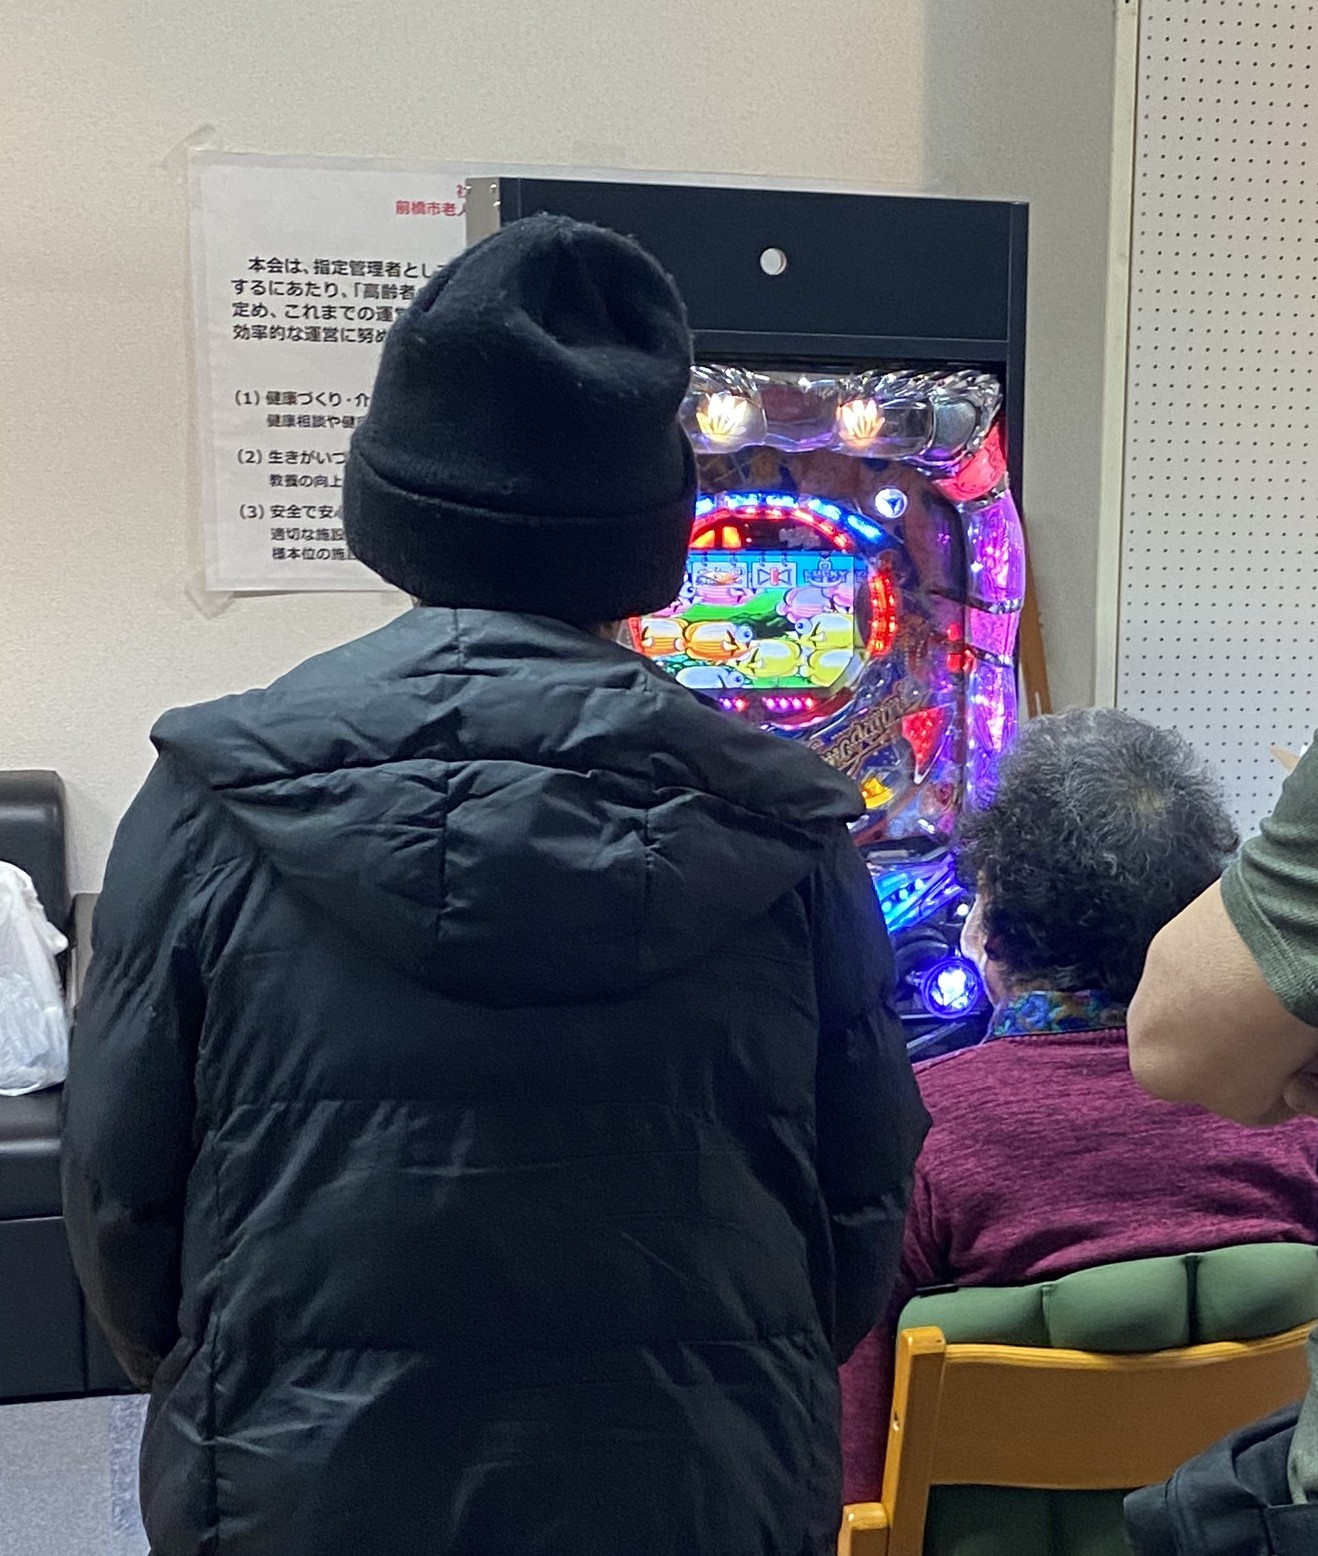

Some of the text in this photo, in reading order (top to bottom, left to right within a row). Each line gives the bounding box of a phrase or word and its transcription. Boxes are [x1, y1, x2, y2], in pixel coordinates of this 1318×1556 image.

[232, 302, 404, 323] 定め、これまでの運
